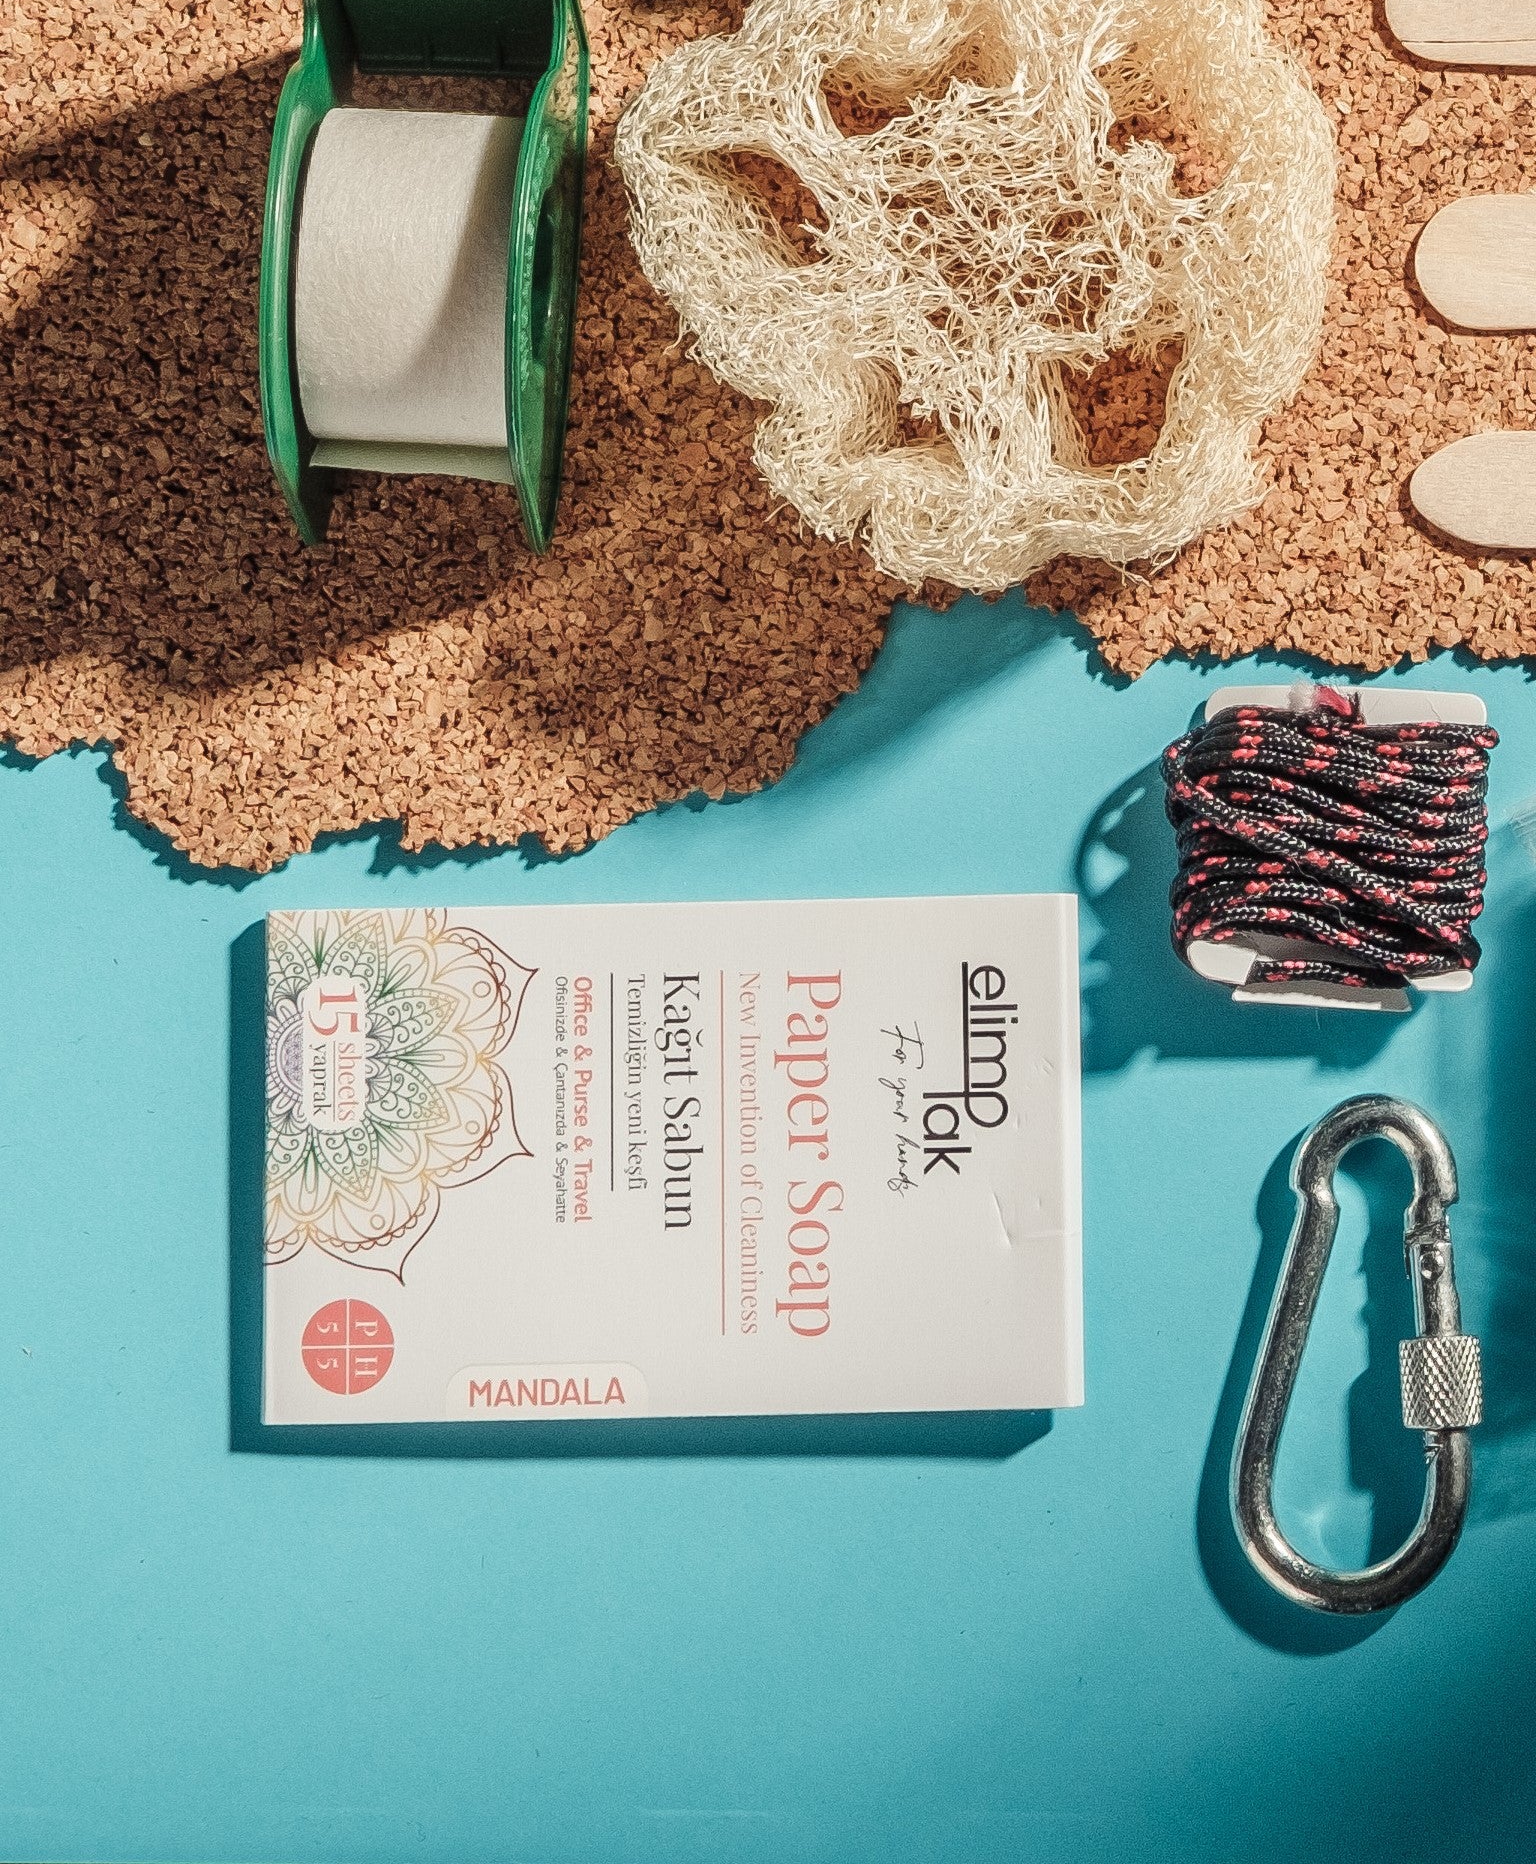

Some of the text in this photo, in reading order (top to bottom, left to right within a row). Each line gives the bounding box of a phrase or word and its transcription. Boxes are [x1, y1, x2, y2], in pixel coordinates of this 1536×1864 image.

[308, 986, 360, 1036] 15
[309, 1043, 332, 1115] yaprak
[338, 1042, 362, 1121] sheets
[624, 973, 648, 1191] Temizliğin yeni keşfi
[880, 1020, 924, 1069] For
[552, 975, 569, 1223] Ofisinizde & Çantanızda & Seyahatte
[573, 976, 593, 1223] Office & Purse & Travel
[654, 971, 704, 1231] Kağıt Sabun
[739, 971, 763, 1335] New Invention of Cleaniness
[774, 969, 844, 1337] Paper Soap
[878, 1076, 909, 1123] your
[469, 1376, 626, 1408] MANDALA
